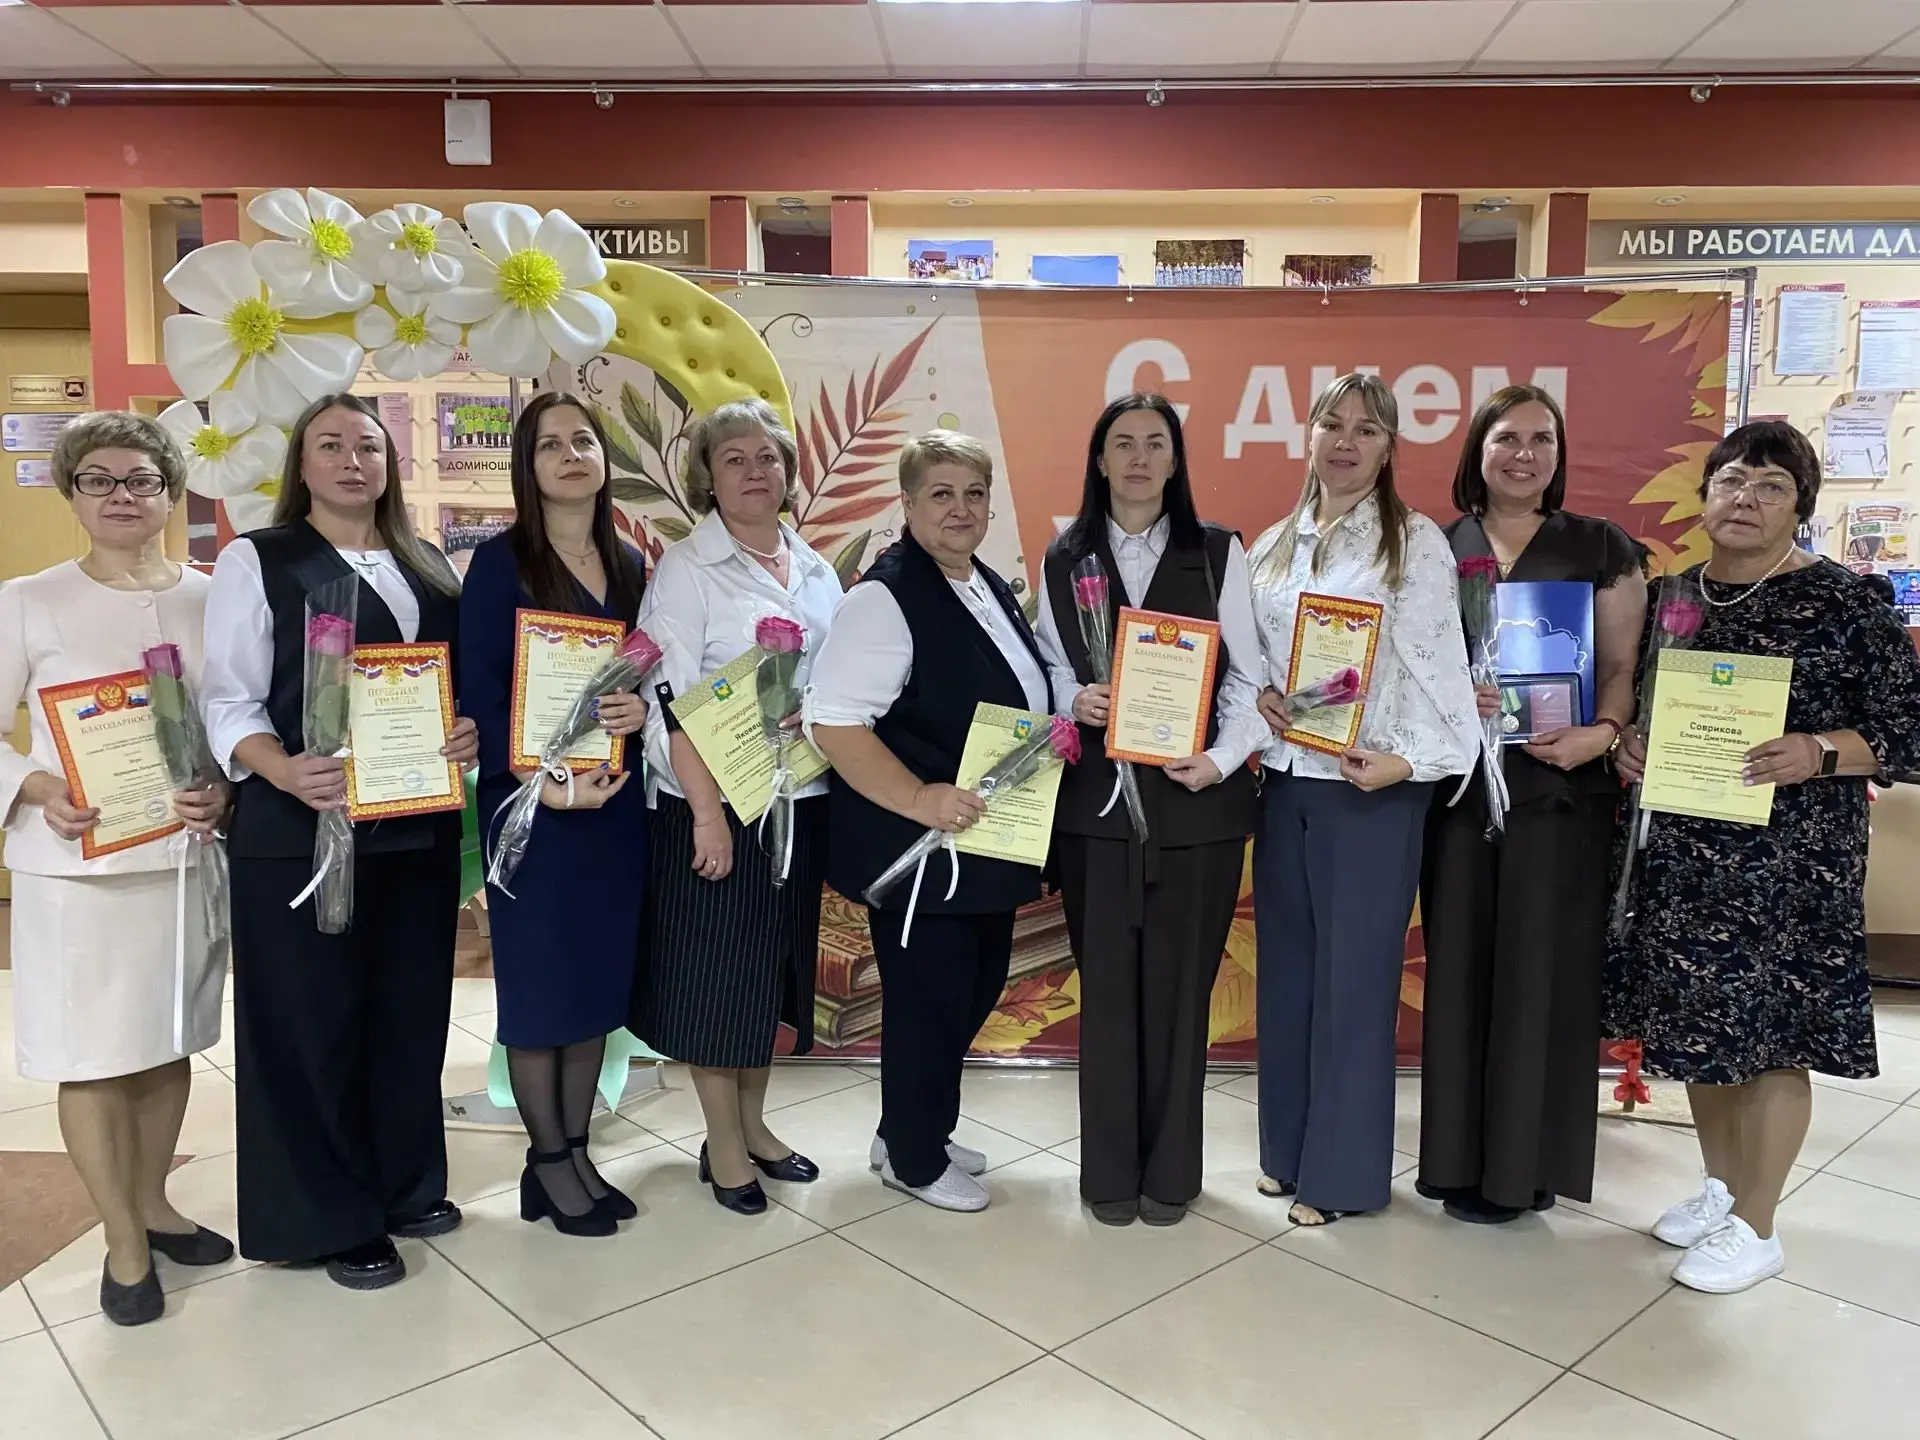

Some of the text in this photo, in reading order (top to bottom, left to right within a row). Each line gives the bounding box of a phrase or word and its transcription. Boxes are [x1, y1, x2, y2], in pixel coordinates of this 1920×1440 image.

[585, 229, 689, 254] КТИВЫ
[1618, 228, 1920, 257] МЫ РАБОТАЕМ ДЛ
[1104, 338, 1568, 460] С дем
[1680, 731, 1751, 746] Елена Дмитриевна
[1689, 721, 1743, 736] Соврикова
